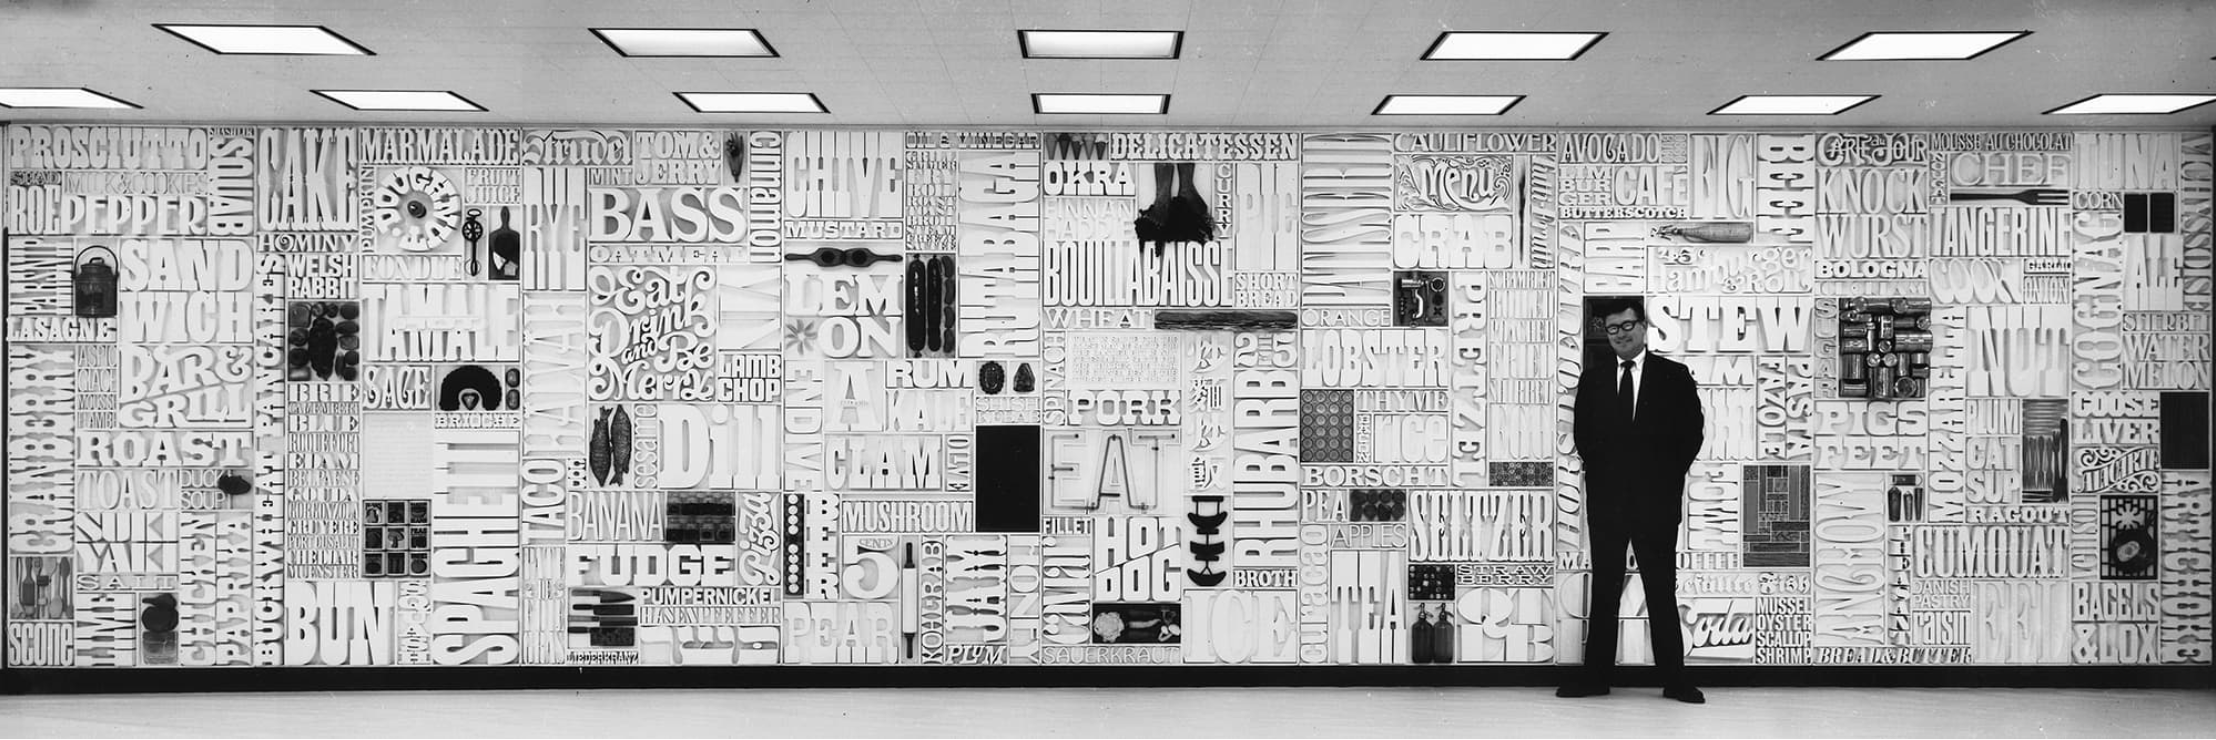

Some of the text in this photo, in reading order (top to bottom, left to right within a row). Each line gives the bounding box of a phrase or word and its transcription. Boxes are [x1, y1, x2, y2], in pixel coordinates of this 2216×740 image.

[10, 126, 207, 169] PROSCIUTTO
[361, 128, 521, 165] MARMALADE
[523, 130, 633, 165] Strudel
[906, 132, 1041, 148] OIL VINEGAR
[1110, 133, 1298, 161] DELICATESSEN
[1394, 134, 1556, 152] CAULIFLOWER
[1560, 134, 1659, 163] AVOCADO
[1932, 134, 2073, 150] MOUSSE AU CHOCOLAT
[210, 138, 254, 236] SQUAB
[258, 128, 358, 231] CAKE
[590, 168, 632, 185] MINT
[636, 160, 722, 185] JERRY
[787, 131, 904, 218] CHIVE
[1044, 163, 1135, 196] OKRA
[1559, 180, 1611, 192] BUR
[1690, 134, 1752, 218] FIG
[1757, 134, 1814, 243] BEEF
[1951, 153, 2073, 187] CHEF
[10, 185, 61, 235] ROE
[361, 167, 376, 253] PUMPKIN
[750, 132, 782, 263] cinnamon
[1216, 164, 1233, 239] CURRY
[1559, 193, 1611, 206] GER
[1816, 169, 1928, 214] KNOCK
[2074, 192, 2122, 210] CORN
[61, 195, 208, 235] PEPPER
[523, 168, 587, 291] RYE
[589, 188, 748, 243] BASS
[785, 222, 903, 239] MUSTARD
[1235, 163, 1299, 270] PIE
[1302, 133, 1392, 306] PATISSERIE
[1559, 207, 1687, 219] BUTTERSCOTCH
[1931, 207, 2071, 257] TANGERINE
[2182, 134, 2212, 311] VICHYSSOISE
[257, 234, 358, 253] HOMINY
[959, 151, 1041, 358] RUTABAGA
[1394, 215, 1513, 269] CRAB
[1816, 215, 1928, 258] WURST
[10, 238, 73, 315] PARSNIP
[120, 239, 254, 291] SAND
[286, 255, 358, 277] WELSH
[363, 256, 462, 280] FONDUE
[1044, 241, 1233, 307] BOUILLABAISSE
[1236, 274, 1298, 290] SHORT
[1816, 261, 1928, 278] BOLOGNA
[2124, 234, 2183, 311] ALE
[288, 277, 358, 299] RABBIT
[785, 275, 904, 317] LEM
[1236, 290, 1298, 307] BREAD
[2025, 278, 2070, 304] ONION
[2073, 211, 2122, 390] COGNAC
[7, 317, 117, 342] LASAGNE
[120, 292, 254, 343] WICH
[362, 284, 521, 362] TAMALE
[817, 317, 904, 358] ON
[1044, 310, 1152, 328] WHEAT
[1302, 310, 1391, 327] ORANGE
[1647, 296, 1813, 353] STEW
[78, 345, 118, 368] ASPIC
[256, 254, 286, 436] PANCAKES
[1302, 330, 1449, 387] LOBSTER
[1967, 307, 2071, 397] NUT
[2123, 333, 2210, 361] WATER
[717, 355, 782, 378] LAMB
[886, 360, 974, 389] RUM
[1043, 332, 1066, 425] SPINACH
[1452, 273, 1488, 487] PRETZEL
[2123, 362, 2210, 390] MELON
[363, 366, 432, 411] SAGE
[717, 379, 782, 402] CHOP
[1068, 390, 1181, 425] PORK
[1357, 390, 1449, 411] THYME
[1785, 356, 1813, 459] PASTA
[288, 415, 359, 432] BLUE
[435, 413, 519, 429] BRIOCHE
[785, 361, 823, 492] ENDIVE
[886, 391, 974, 432] KALE
[1815, 400, 1926, 436] PIGS
[1929, 308, 1964, 523] MOZZARELLA
[1966, 399, 2020, 434] PLUM
[2073, 419, 2159, 443] LIVER
[10, 347, 75, 554] CRANBERRY
[77, 431, 254, 467] ROAST
[634, 403, 657, 488] sesame
[660, 403, 782, 490] Dill
[825, 436, 942, 490] CLAM
[948, 436, 970, 491] OLIVE
[1815, 437, 1926, 470] FEET
[1966, 437, 2020, 470] CAT
[1045, 429, 1181, 513] EAT
[1234, 371, 1298, 567] RHUBARB
[1302, 466, 1449, 487] BORSCHT
[1966, 471, 2020, 503] SUP
[77, 470, 180, 510] TOAST
[181, 491, 226, 510] SOUP
[521, 459, 566, 545] TACO
[1301, 490, 1348, 522] PEA
[77, 512, 179, 541] SUKI
[568, 491, 664, 541] BANANA
[842, 500, 974, 533] MUSHROOM
[1044, 519, 1091, 534] FILLET
[1409, 490, 1555, 562] SELTZER
[1966, 507, 2070, 523] RAGOUT
[433, 431, 521, 666] SPAGHETTI
[859, 537, 893, 549] CENTS
[1094, 517, 1181, 573] HOT
[1331, 525, 1407, 548] APPLES
[77, 542, 179, 572] YAKI
[256, 452, 286, 666] BUCKWHEAT
[567, 545, 736, 586] FUDGE
[842, 536, 899, 600] 5
[1095, 543, 1181, 602] DOG
[1458, 564, 1552, 575] STRAW
[1815, 474, 1885, 646] ANCHOVY
[2161, 473, 2212, 665] ARTICHOKE
[77, 574, 179, 590] SALT
[180, 512, 216, 666] CHICKEN
[216, 514, 254, 666] PAPRIKA
[640, 588, 780, 606] PUMPERNICKEL
[946, 536, 1007, 643] JAM
[1234, 570, 1298, 587] BROTH
[1458, 575, 1551, 586] BERRY
[1913, 580, 1971, 595] DANISH
[921, 536, 944, 664] KOHLRABI
[1009, 536, 1040, 664] HONEY
[1331, 551, 1407, 664] TEA
[1757, 598, 1812, 614] MUSSEL
[1913, 595, 1971, 610] PASTRY
[2073, 582, 2159, 621] BAGELS
[76, 593, 137, 667] LIME
[285, 581, 394, 666] BUN
[784, 602, 899, 664] PEAR
[1184, 590, 1298, 664] ICE
[1757, 614, 1812, 631] OYSTER
[1757, 631, 1812, 648] SCALLOP
[947, 646, 1007, 665] PLUM
[1043, 646, 1181, 665] SAUERKRAUT
[1757, 648, 1812, 665] SHRIMP
[2100, 623, 2159, 664] LOX
